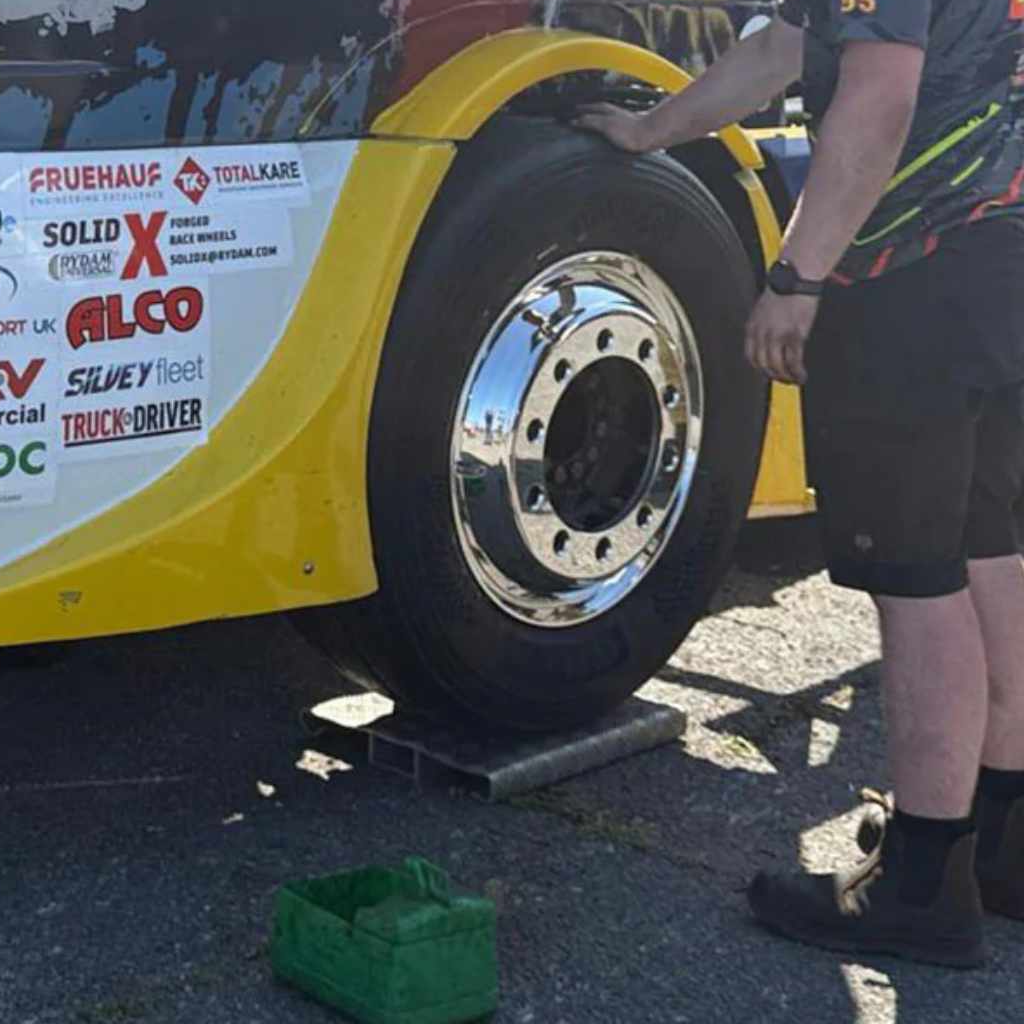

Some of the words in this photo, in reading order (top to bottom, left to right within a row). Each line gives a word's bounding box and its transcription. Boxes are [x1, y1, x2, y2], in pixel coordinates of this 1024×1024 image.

[29, 161, 162, 193] FRUEHAUF
[213, 161, 301, 184] TOTALKARE
[170, 216, 209, 229] FORGED
[43, 218, 120, 248] SOLID
[120, 210, 168, 281] X
[169, 233, 194, 246] RACE
[197, 229, 237, 243] WHEELS
[170, 246, 277, 267] SOLIDX@RYDAM.COM
[33, 317, 56, 334] UK
[65, 286, 204, 349] ALCO
[156, 355, 204, 385] fleet
